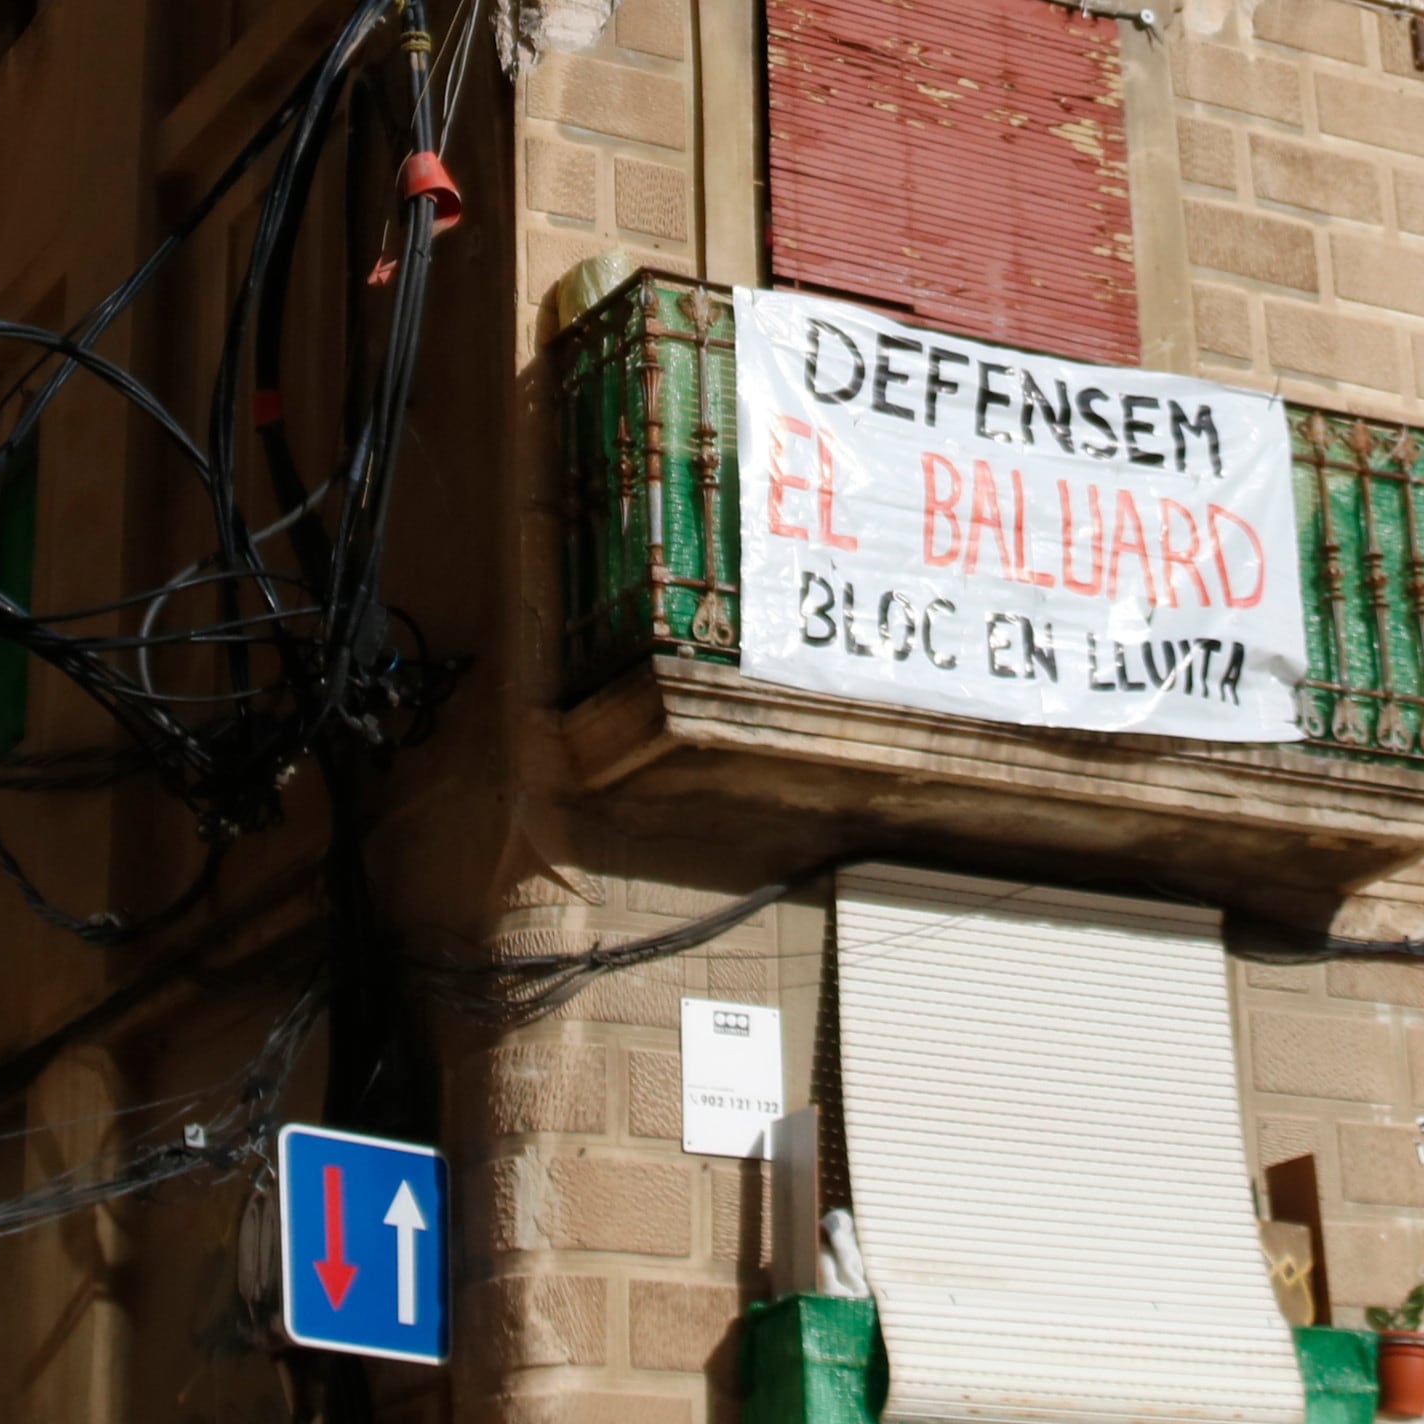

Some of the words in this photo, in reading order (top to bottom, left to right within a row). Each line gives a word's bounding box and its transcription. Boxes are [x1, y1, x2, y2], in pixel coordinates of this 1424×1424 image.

[804, 317, 1224, 478] DEFENSEM
[766, 414, 859, 552] EL
[920, 450, 1267, 610] BALUARD
[798, 570, 957, 670] BLOC
[985, 612, 1059, 684] EN
[1086, 631, 1246, 707] LLUITA
[700, 1094, 724, 1108] 902
[730, 1097, 750, 1111] 121
[757, 1099, 779, 1114] 122
